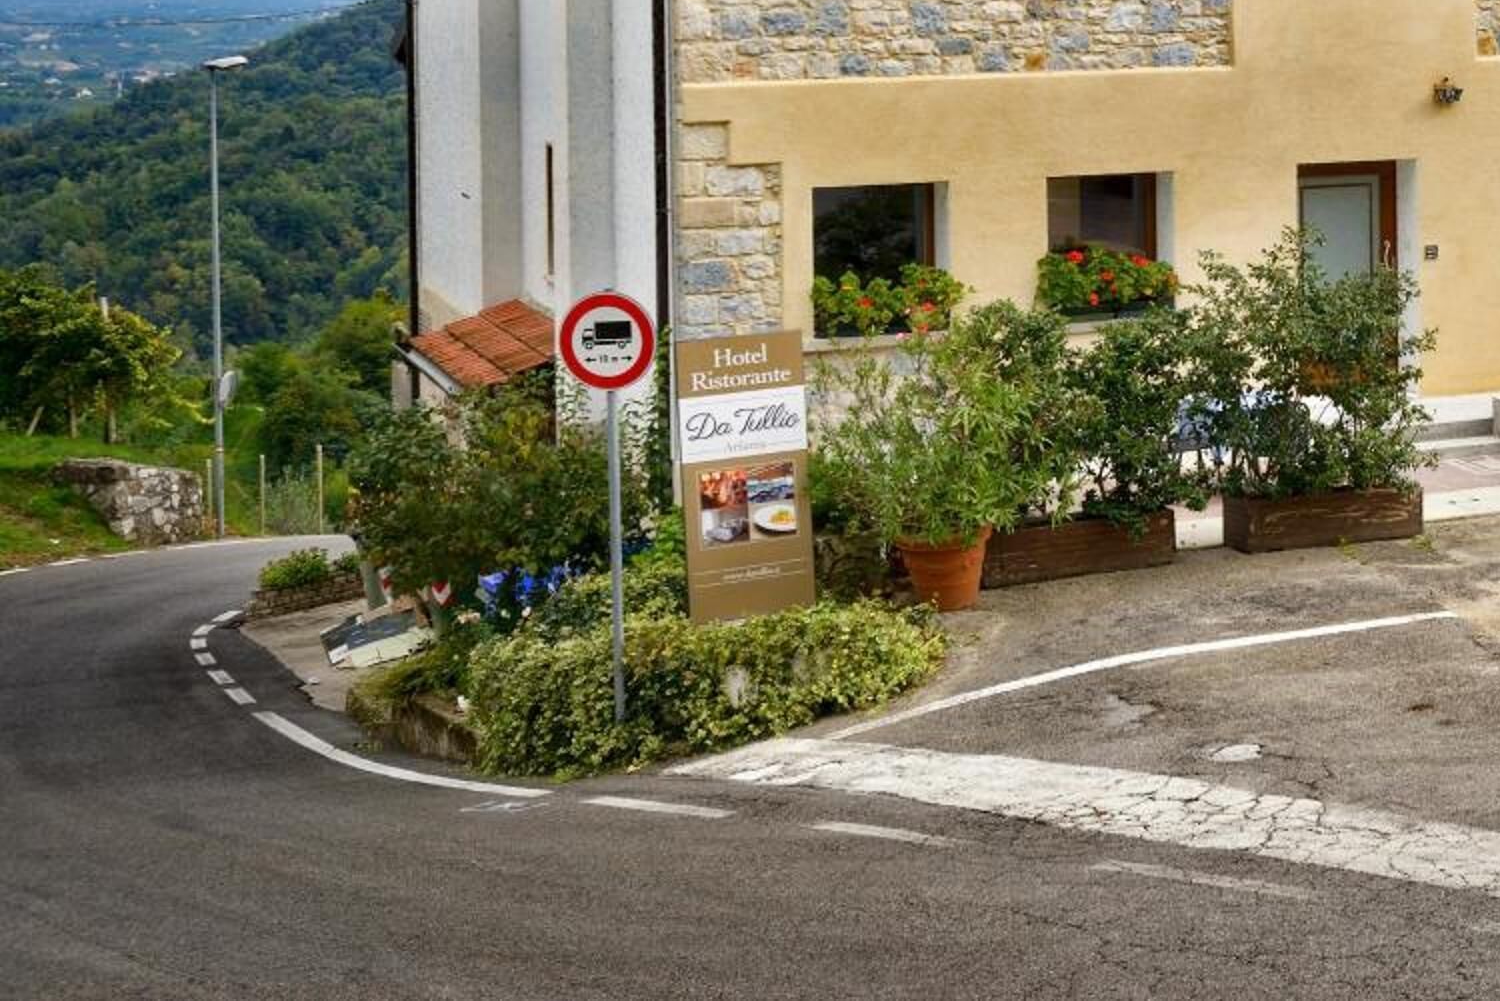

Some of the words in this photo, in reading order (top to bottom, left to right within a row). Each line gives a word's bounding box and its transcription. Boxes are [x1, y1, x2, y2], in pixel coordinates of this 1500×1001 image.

[713, 343, 767, 368] Hotel
[690, 368, 792, 392] Ristorante
[685, 412, 733, 441] Da
[733, 402, 801, 436] Tullio
